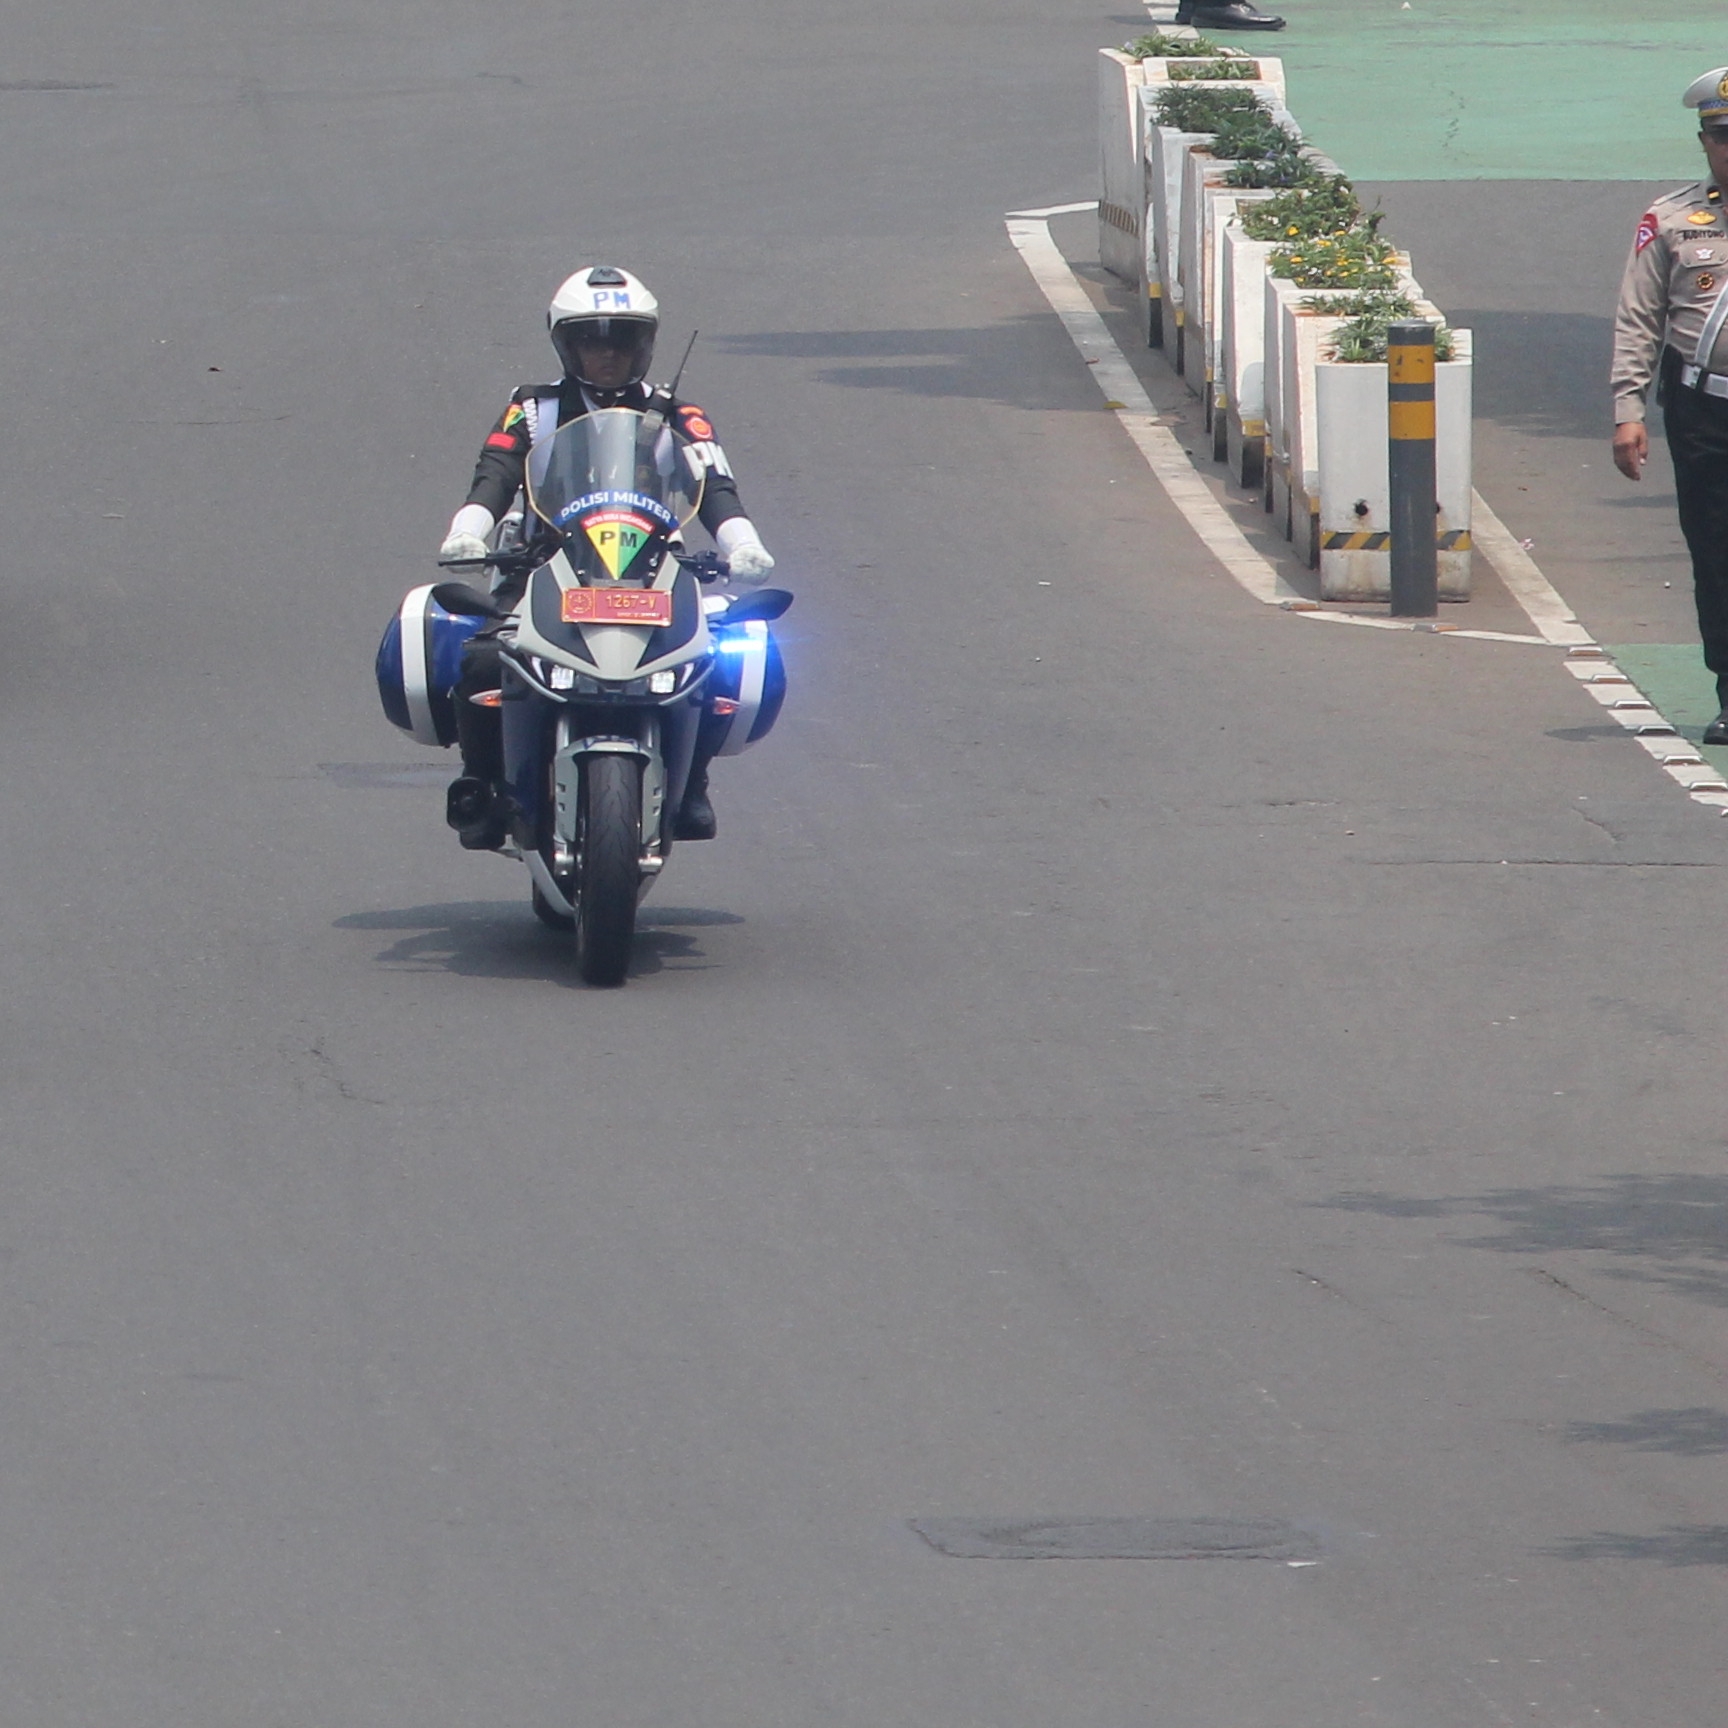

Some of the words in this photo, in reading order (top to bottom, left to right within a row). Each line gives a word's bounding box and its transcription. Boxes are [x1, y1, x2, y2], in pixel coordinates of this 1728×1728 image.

[594, 292, 630, 309] PM
[561, 493, 608, 520] POLISI
[614, 491, 671, 523] MILITER
[600, 531, 637, 548] PM
